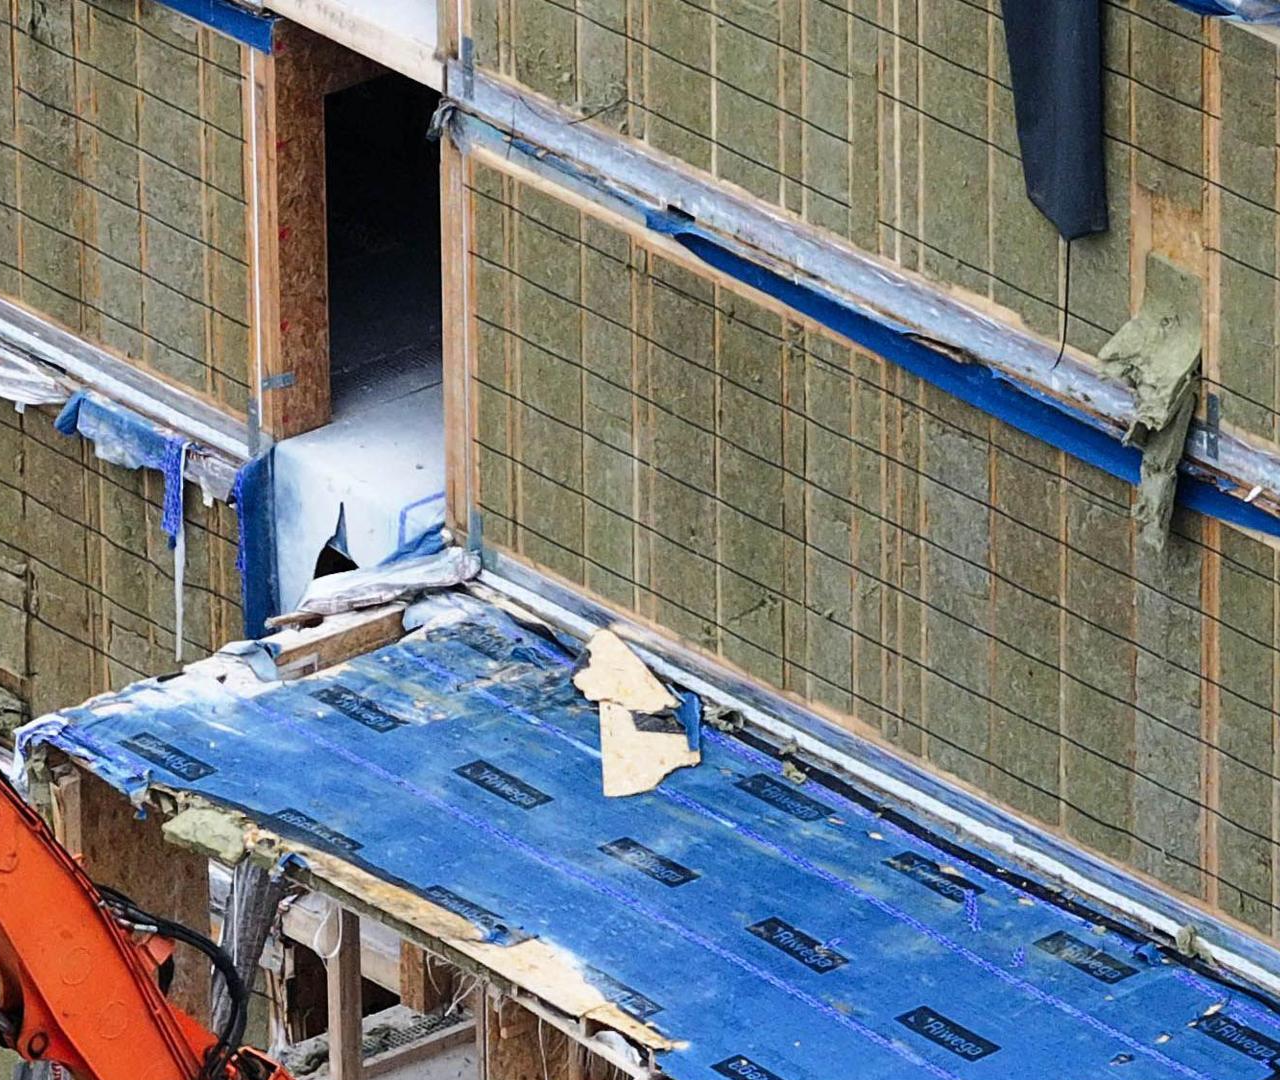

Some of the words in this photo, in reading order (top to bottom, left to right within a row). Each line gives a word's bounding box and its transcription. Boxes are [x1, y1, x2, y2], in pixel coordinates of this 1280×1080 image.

[772, 928, 833, 969] Riwega
[1065, 940, 1121, 979] Riwega
[924, 1016, 984, 1056] Riwega
[1218, 1019, 1277, 1058] Riwega
